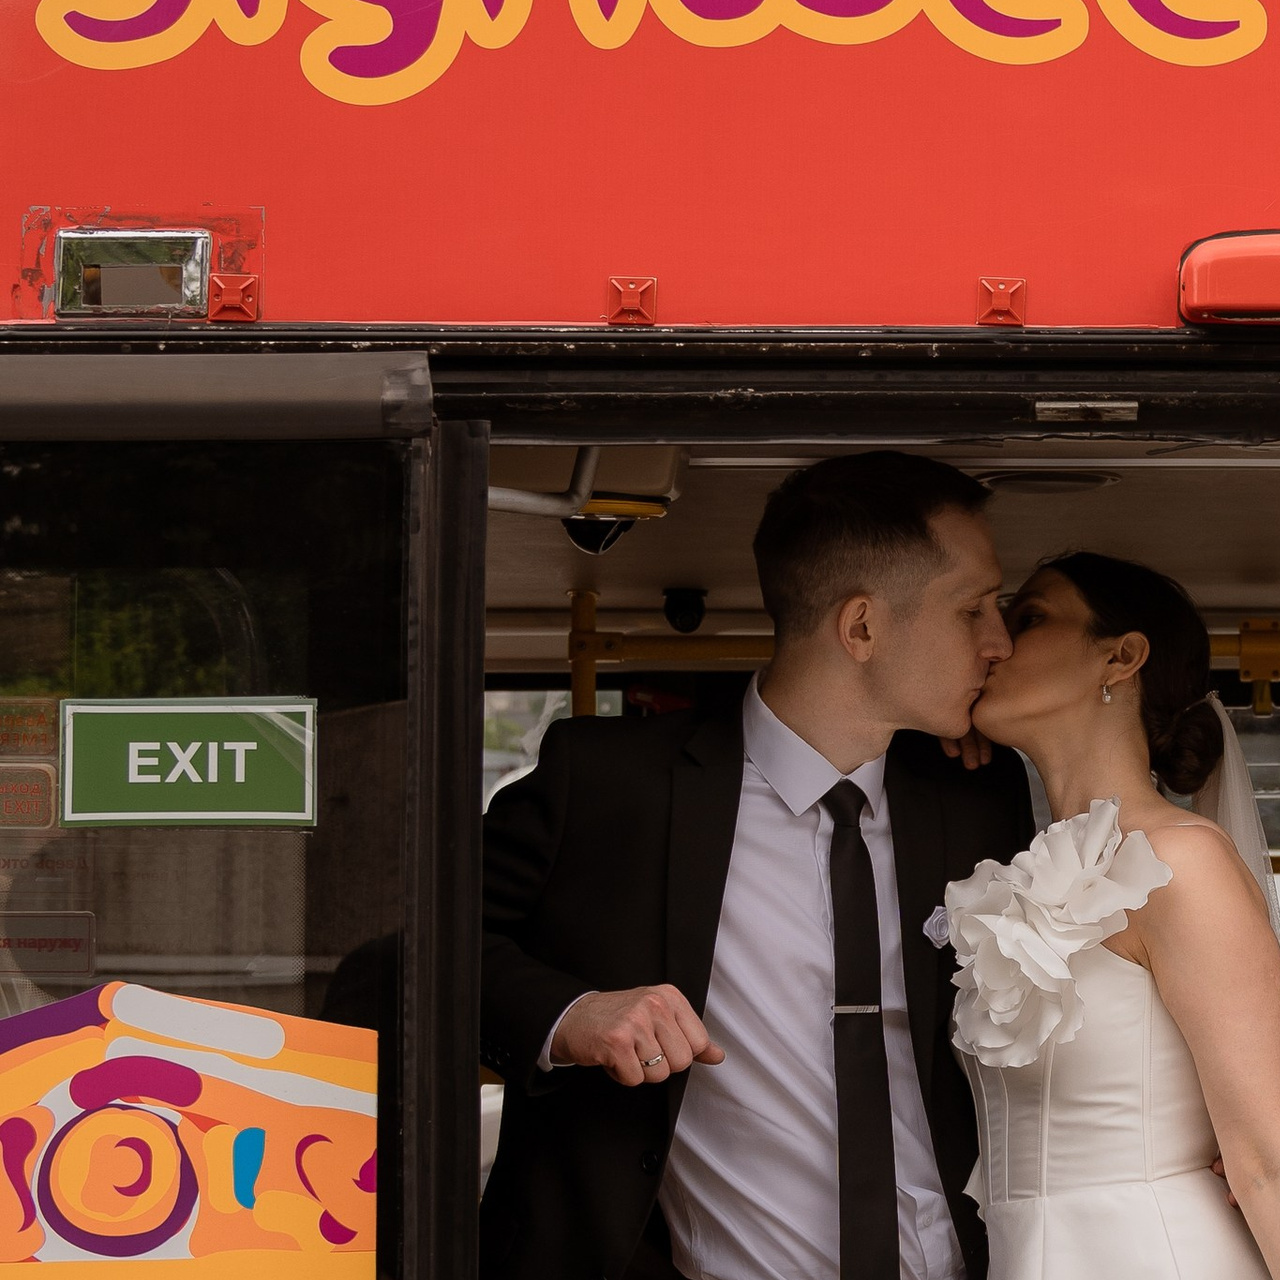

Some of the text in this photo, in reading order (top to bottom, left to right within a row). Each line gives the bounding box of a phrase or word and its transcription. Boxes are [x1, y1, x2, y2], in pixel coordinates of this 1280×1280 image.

[128, 740, 258, 784] EXIT
[0, 782, 43, 797] ыход
[4, 799, 44, 815] EXIT
[16, 937, 81, 952] наружу
